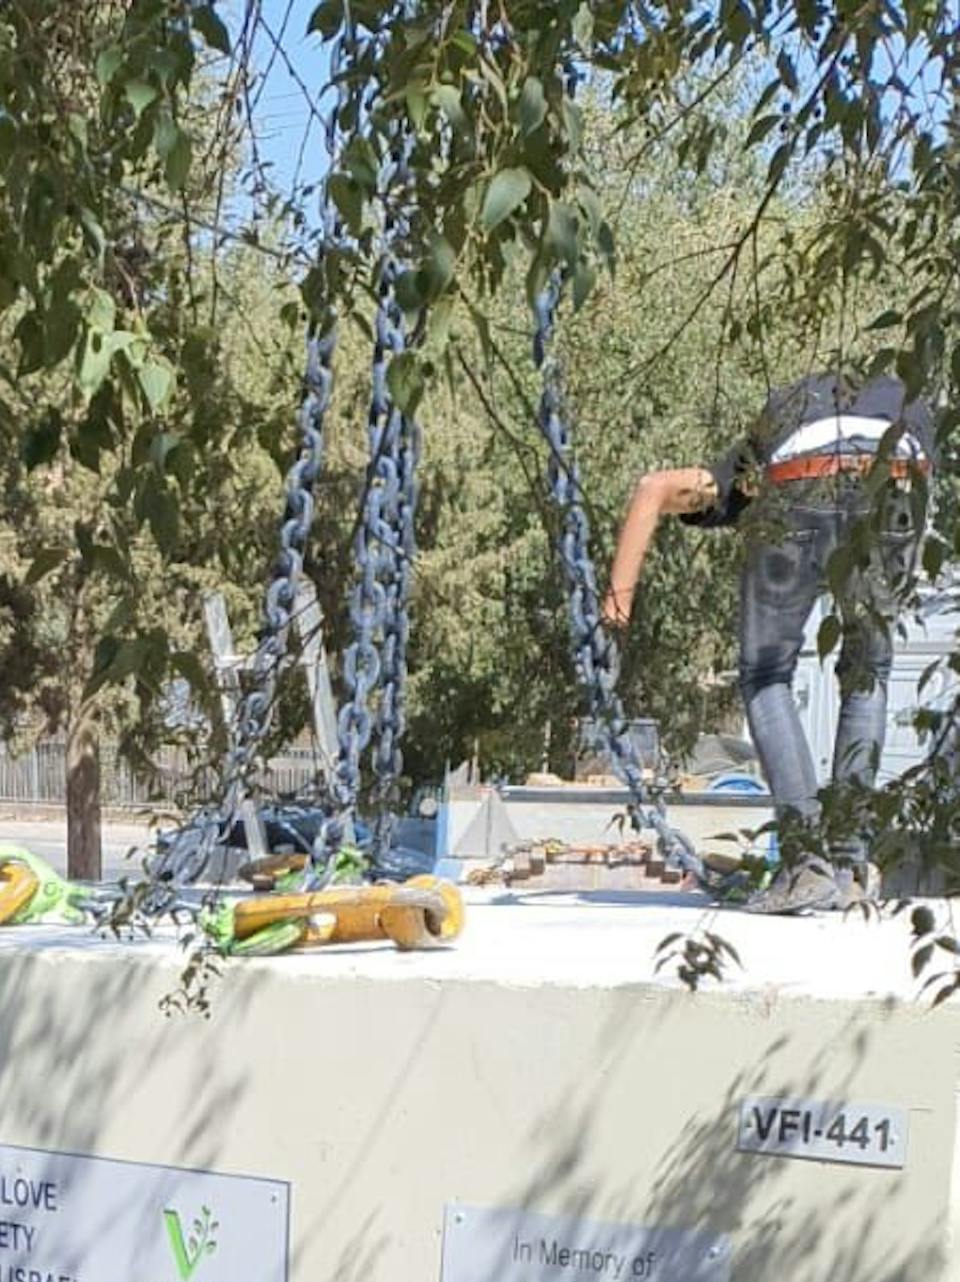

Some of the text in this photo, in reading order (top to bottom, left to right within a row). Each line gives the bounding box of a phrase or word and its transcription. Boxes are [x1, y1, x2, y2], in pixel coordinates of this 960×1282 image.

[753, 1107, 890, 1152] VFI-441
[2, 1177, 58, 1212] LOVE
[512, 1236, 657, 1280] In Memory of
